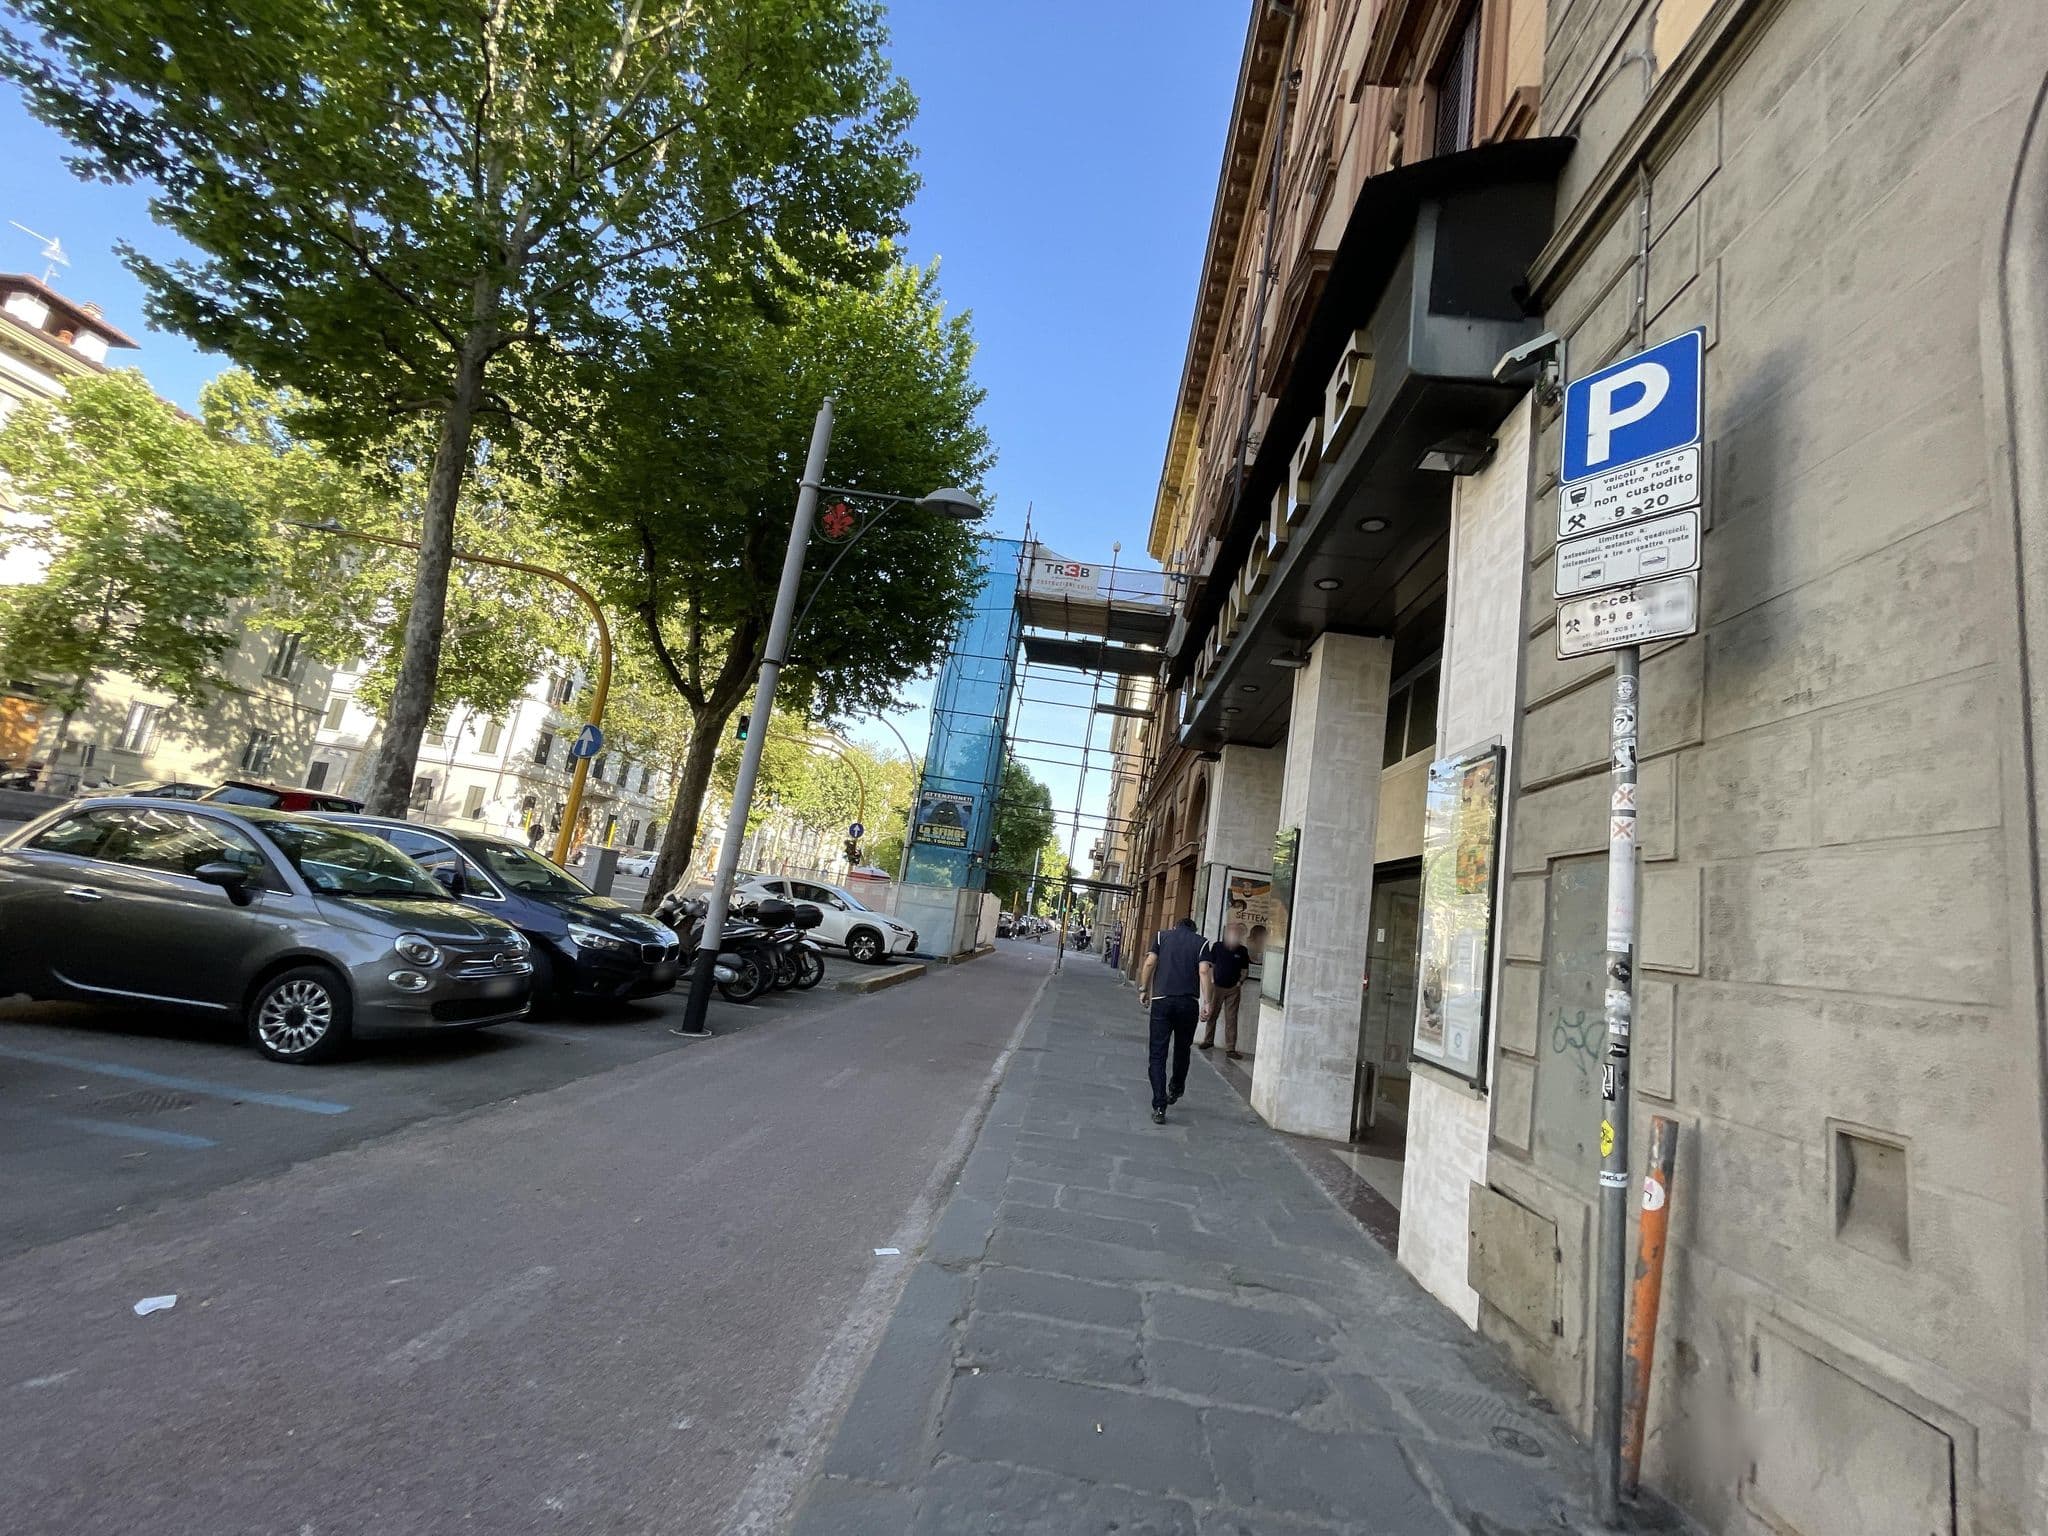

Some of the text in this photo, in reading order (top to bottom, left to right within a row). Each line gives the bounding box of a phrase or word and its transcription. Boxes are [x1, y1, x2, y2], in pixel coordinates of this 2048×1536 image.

[1587, 362, 1670, 466] P
[1603, 469, 1636, 484] veicoli
[1655, 459, 1671, 469] tre
[1606, 464, 1680, 492] quattro ruote
[1594, 472, 1693, 507] non custodito
[1598, 531, 1634, 544] limitato
[1045, 563, 1090, 578] TR3B
